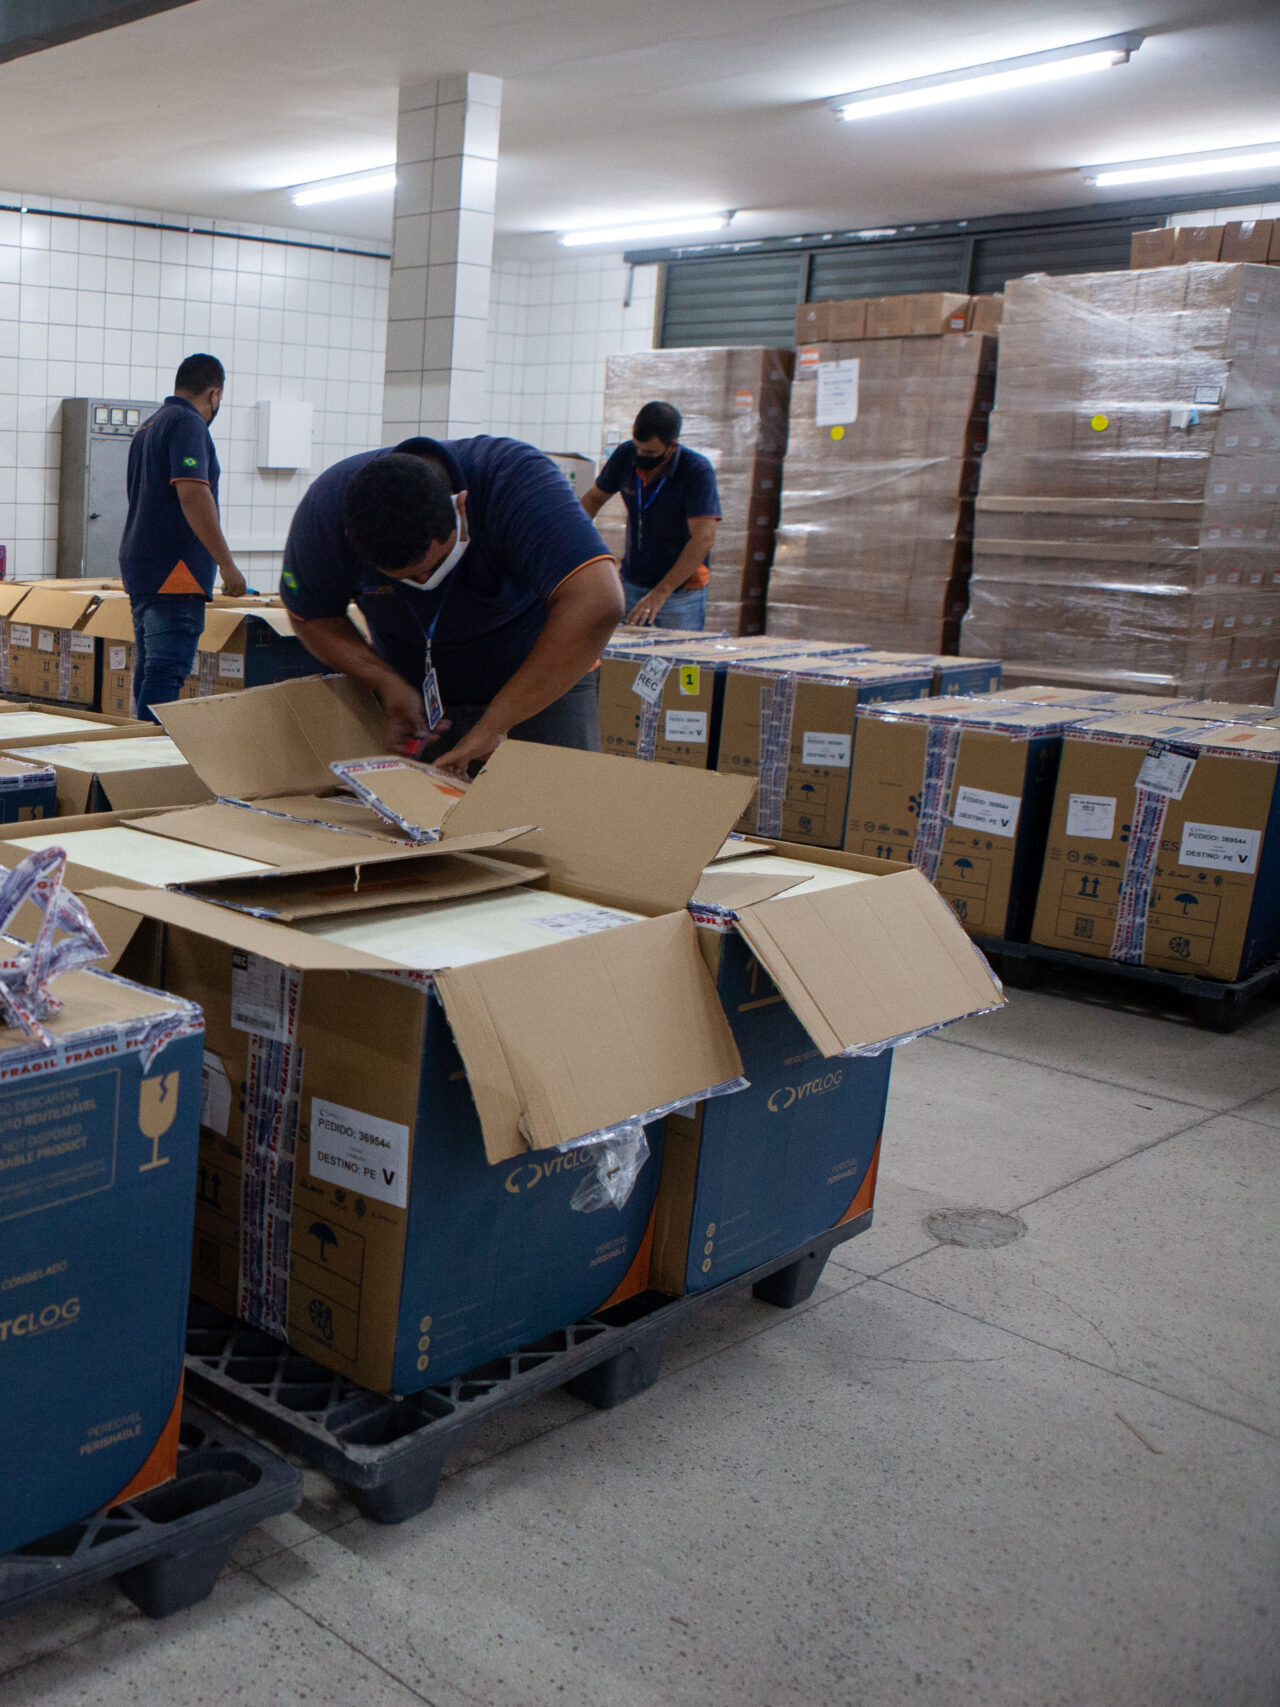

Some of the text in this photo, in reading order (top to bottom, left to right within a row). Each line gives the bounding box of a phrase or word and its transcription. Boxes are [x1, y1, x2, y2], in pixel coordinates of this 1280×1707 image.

[639, 673, 659, 692] REC
[686, 674, 694, 685] 1
[1001, 818, 1010, 827] V
[1238, 855, 1248, 863] V
[1, 1059, 58, 1079] FRÁGIL
[66, 1044, 118, 1064] FRÁGIL
[796, 1069, 843, 1099] VTCLOG
[318, 1118, 357, 1140] PEDIDO:
[317, 1151, 361, 1175] DESTINO:
[363, 1167, 377, 1180] PE
[382, 1168, 395, 1185] V
[1, 1259, 68, 1291] CONGELADO
